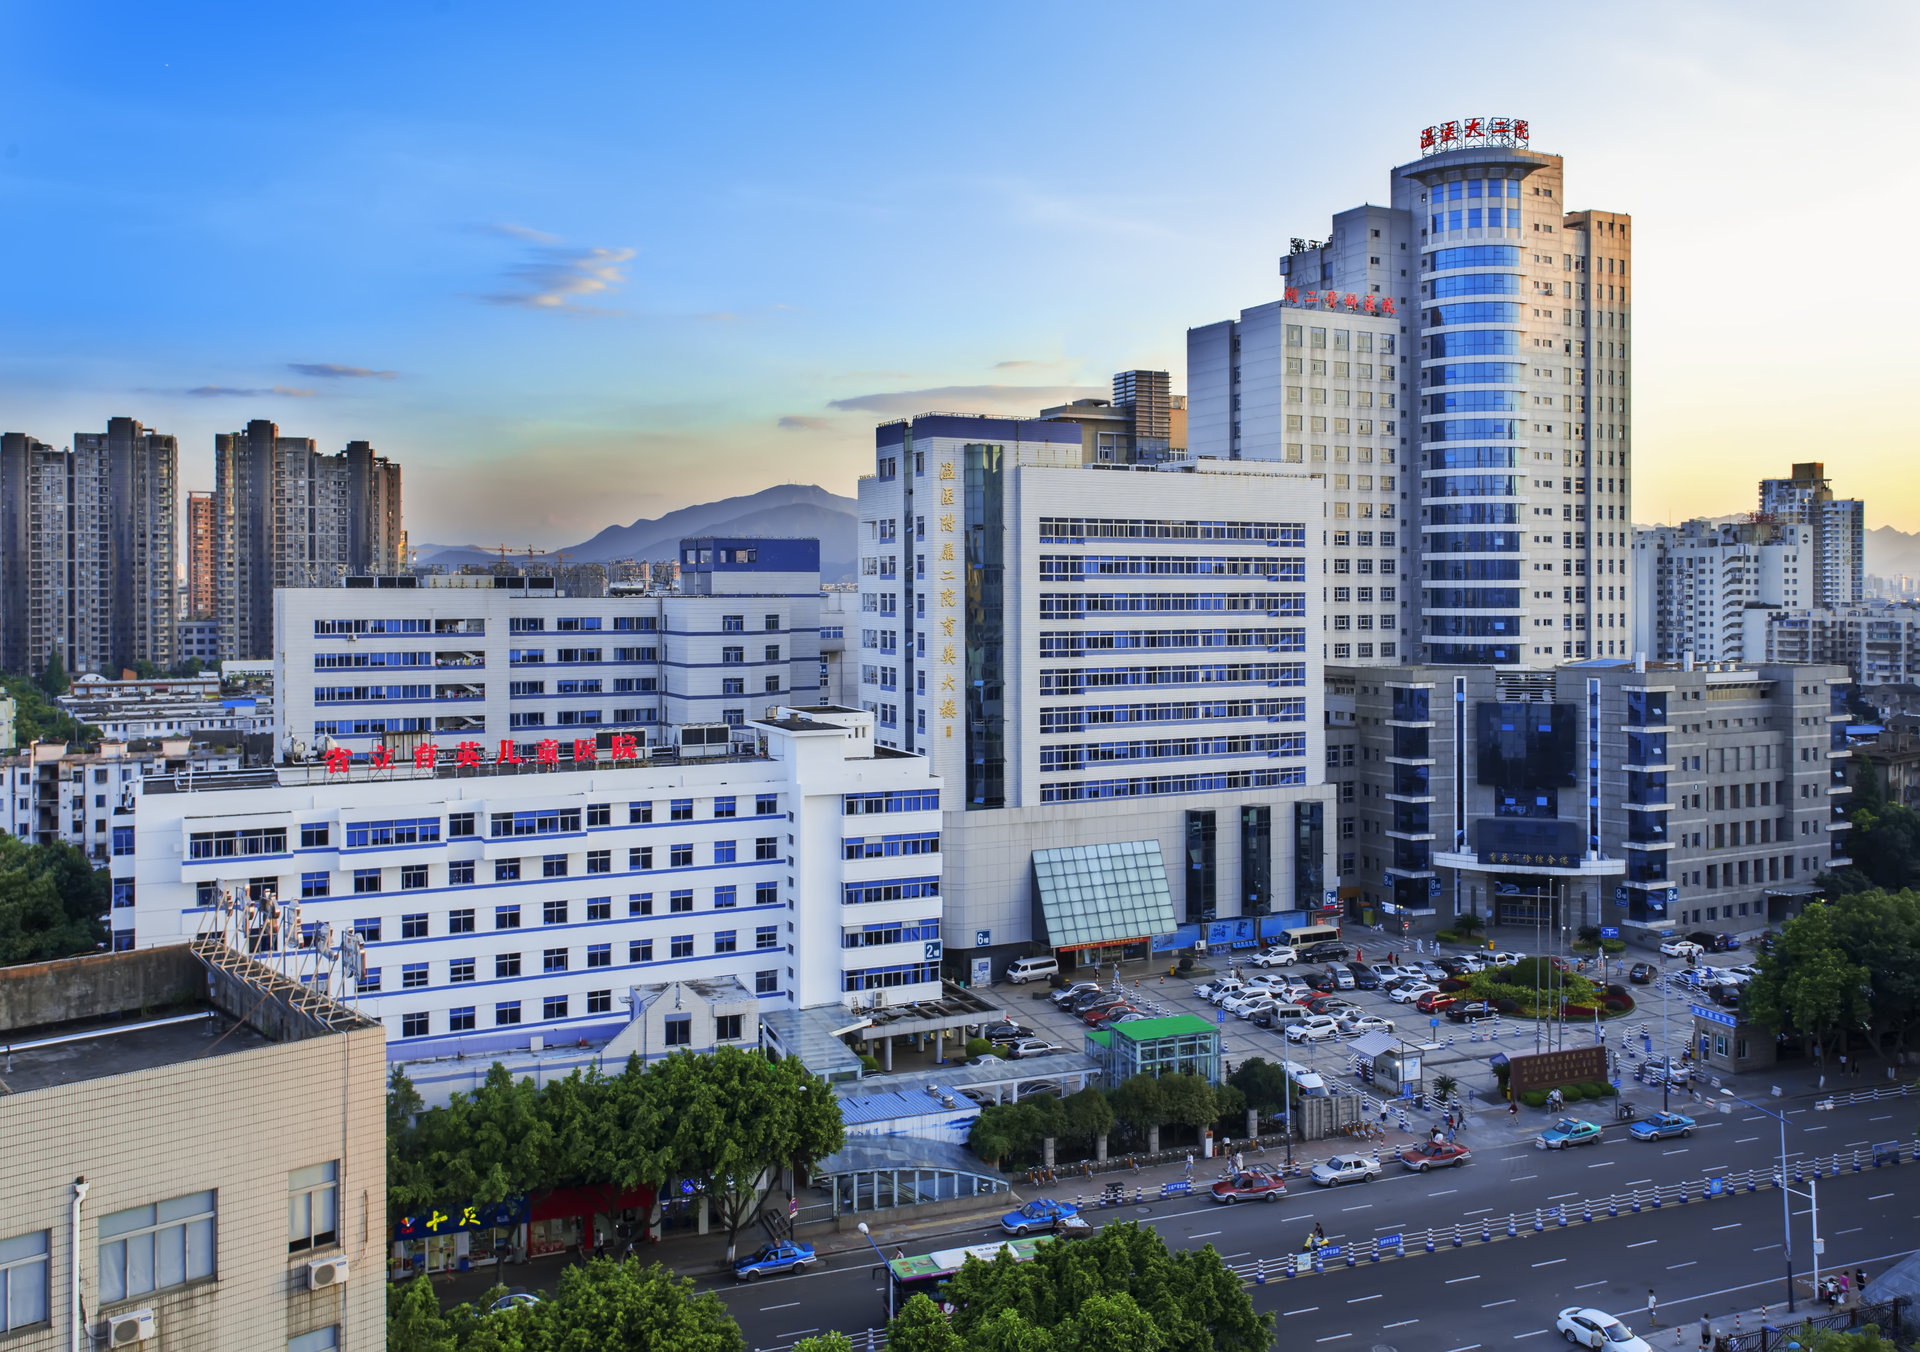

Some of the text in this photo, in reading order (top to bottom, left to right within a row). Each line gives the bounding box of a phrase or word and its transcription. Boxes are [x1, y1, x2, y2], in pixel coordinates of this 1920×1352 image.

[1420, 118, 1529, 149] 温医大二院
[1284, 286, 1396, 314] 附二骨科医院
[939, 462, 957, 719] 温医附属二院育英大楼
[323, 734, 638, 774] 省立育英儿童医院
